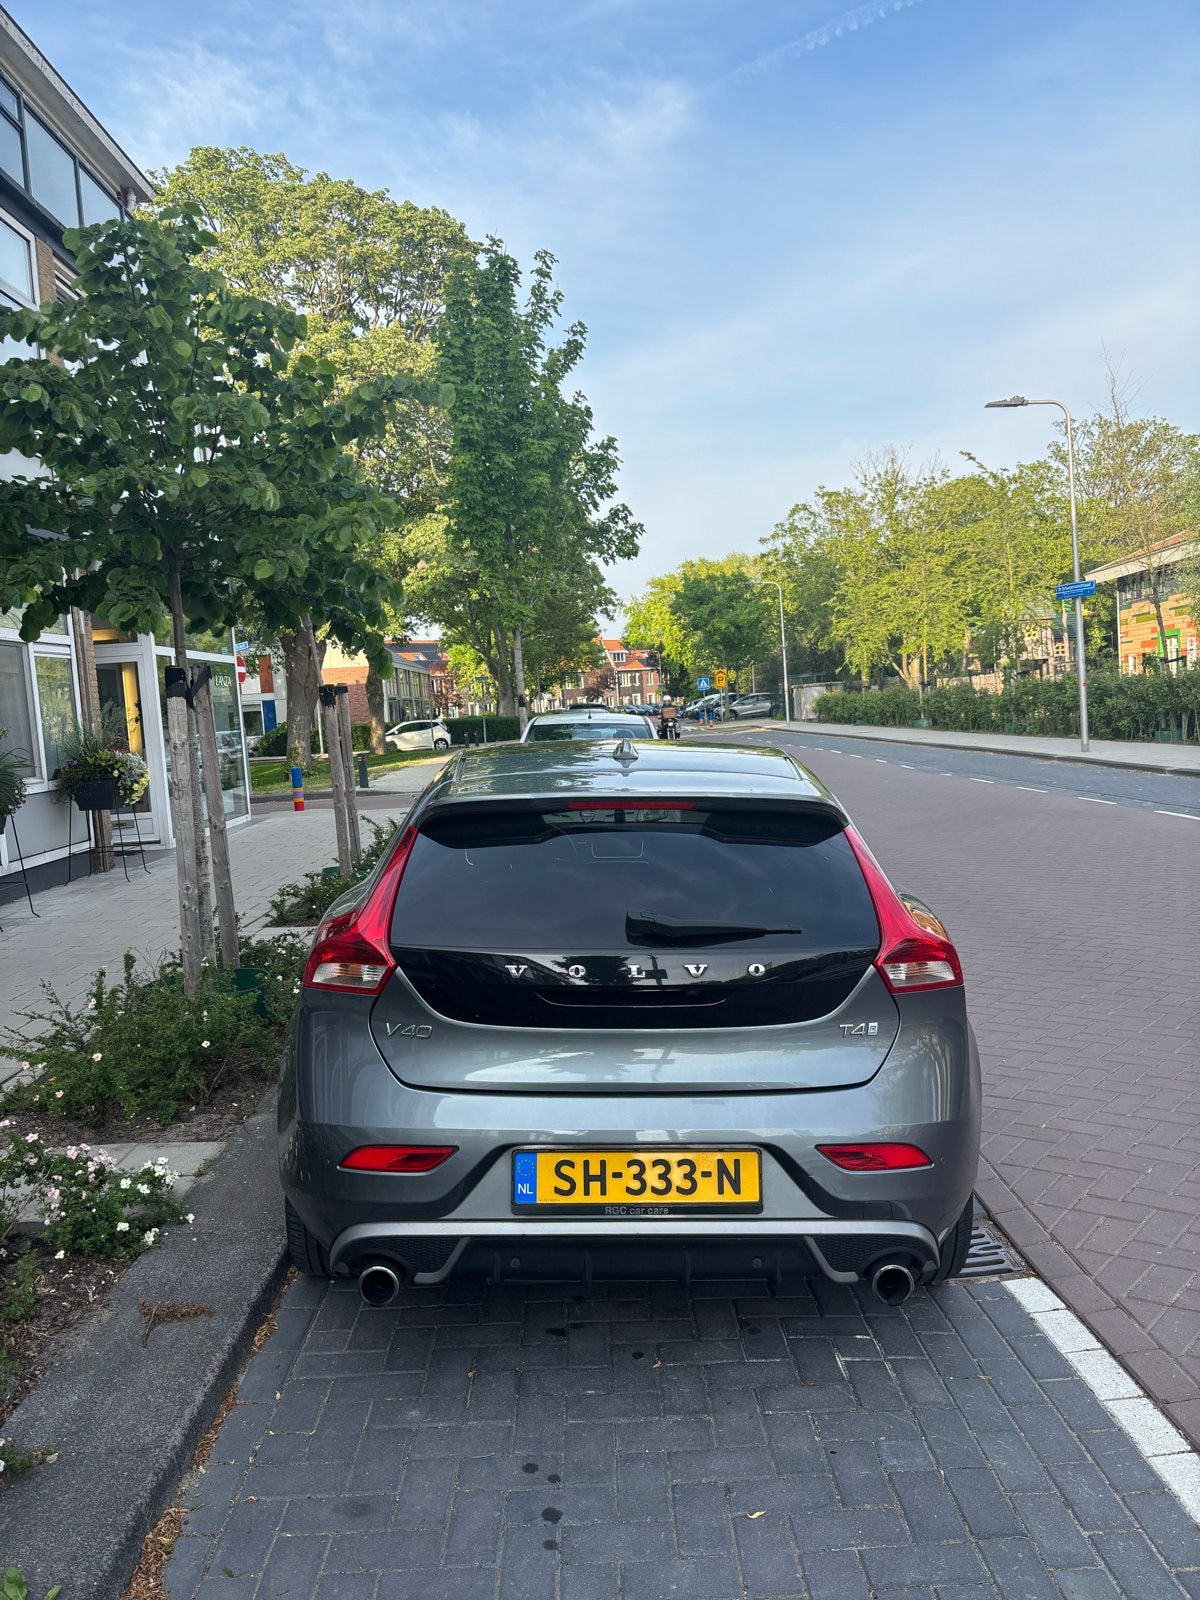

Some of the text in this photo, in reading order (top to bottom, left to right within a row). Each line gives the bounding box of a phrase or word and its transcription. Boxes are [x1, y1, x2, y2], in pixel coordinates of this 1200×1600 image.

[718, 676, 724, 684] P
[505, 963, 766, 979] VOLVO
[386, 1022, 432, 1039] V40
[839, 1022, 866, 1038] T4
[553, 1158, 742, 1197] SH-333-N
[517, 1183, 534, 1195] NL
[604, 1206, 669, 1215] RGC car care
